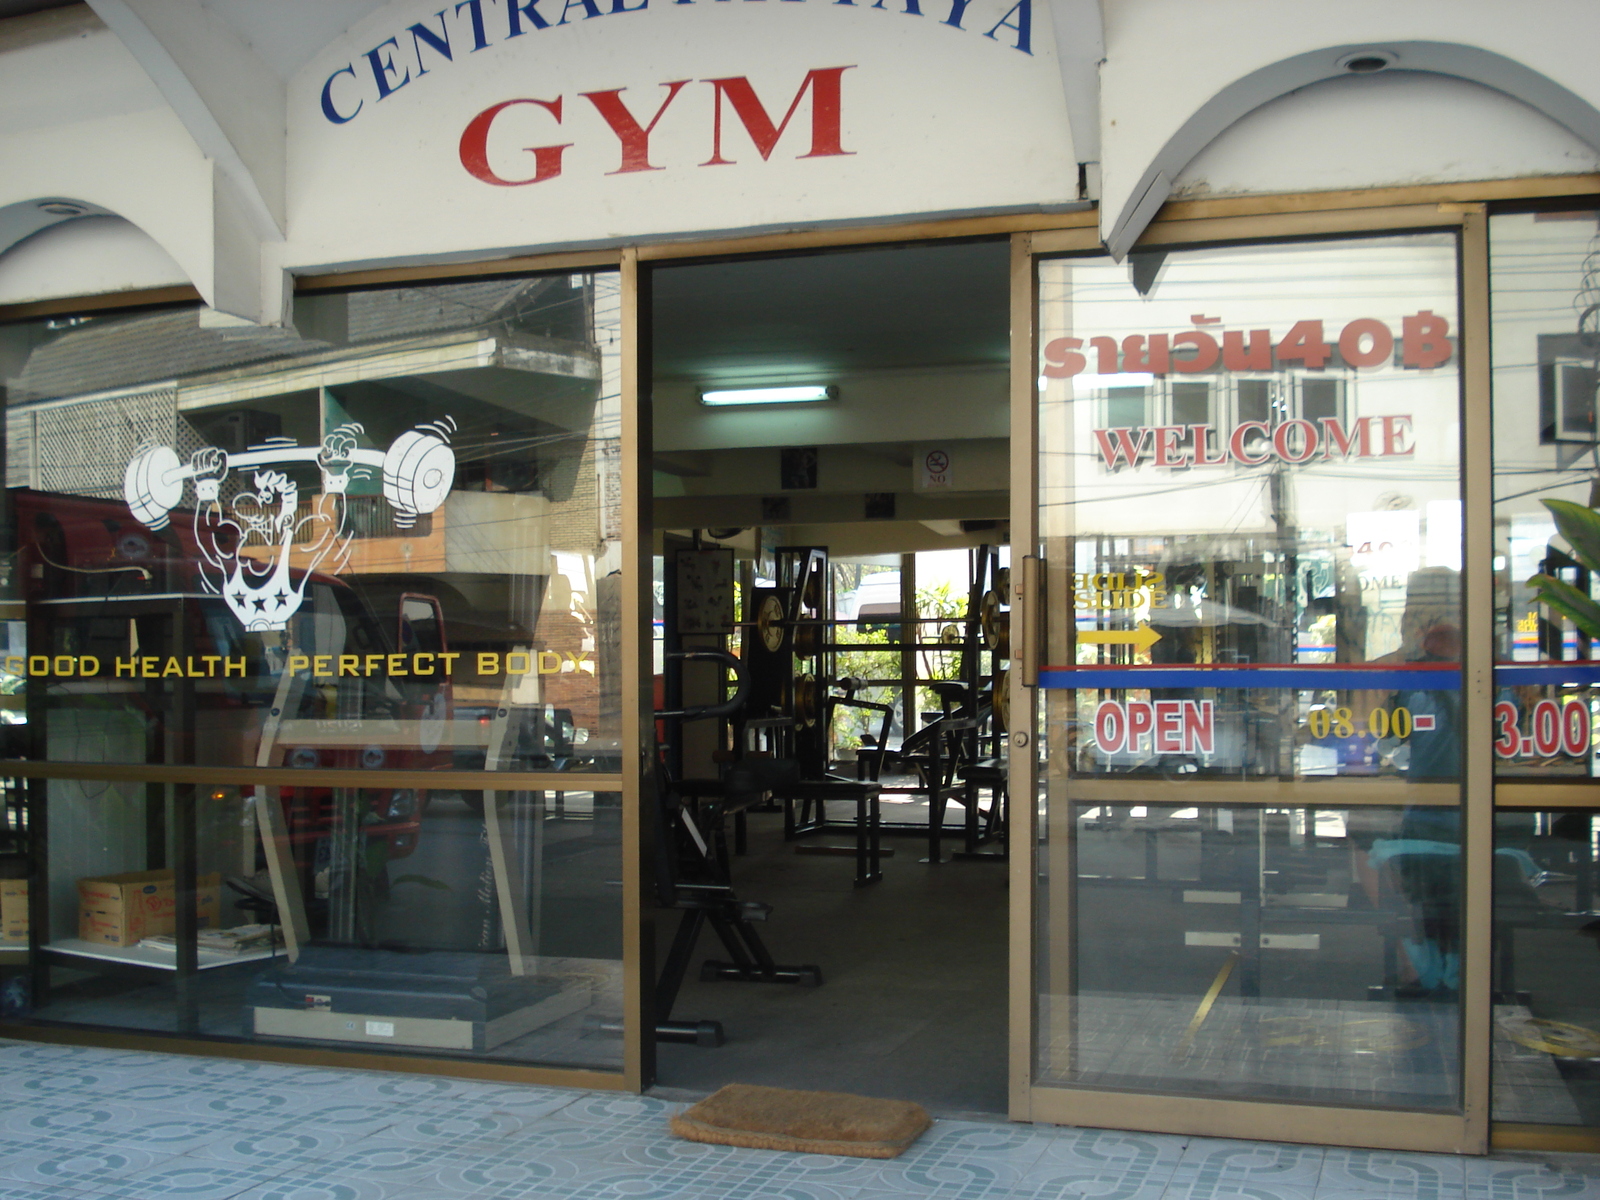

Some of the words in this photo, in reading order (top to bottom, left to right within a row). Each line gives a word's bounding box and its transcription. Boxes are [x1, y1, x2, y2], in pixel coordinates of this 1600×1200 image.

[459, 65, 858, 186] GYM
[1092, 414, 1416, 470] WELCOME
[1072, 591, 1167, 609] SLIDE
[5, 656, 99, 677] GOOD
[115, 656, 247, 678] HEALTH
[289, 653, 460, 677] PERFECT
[477, 652, 590, 675] BODY
[1094, 699, 1214, 754] OPEN
